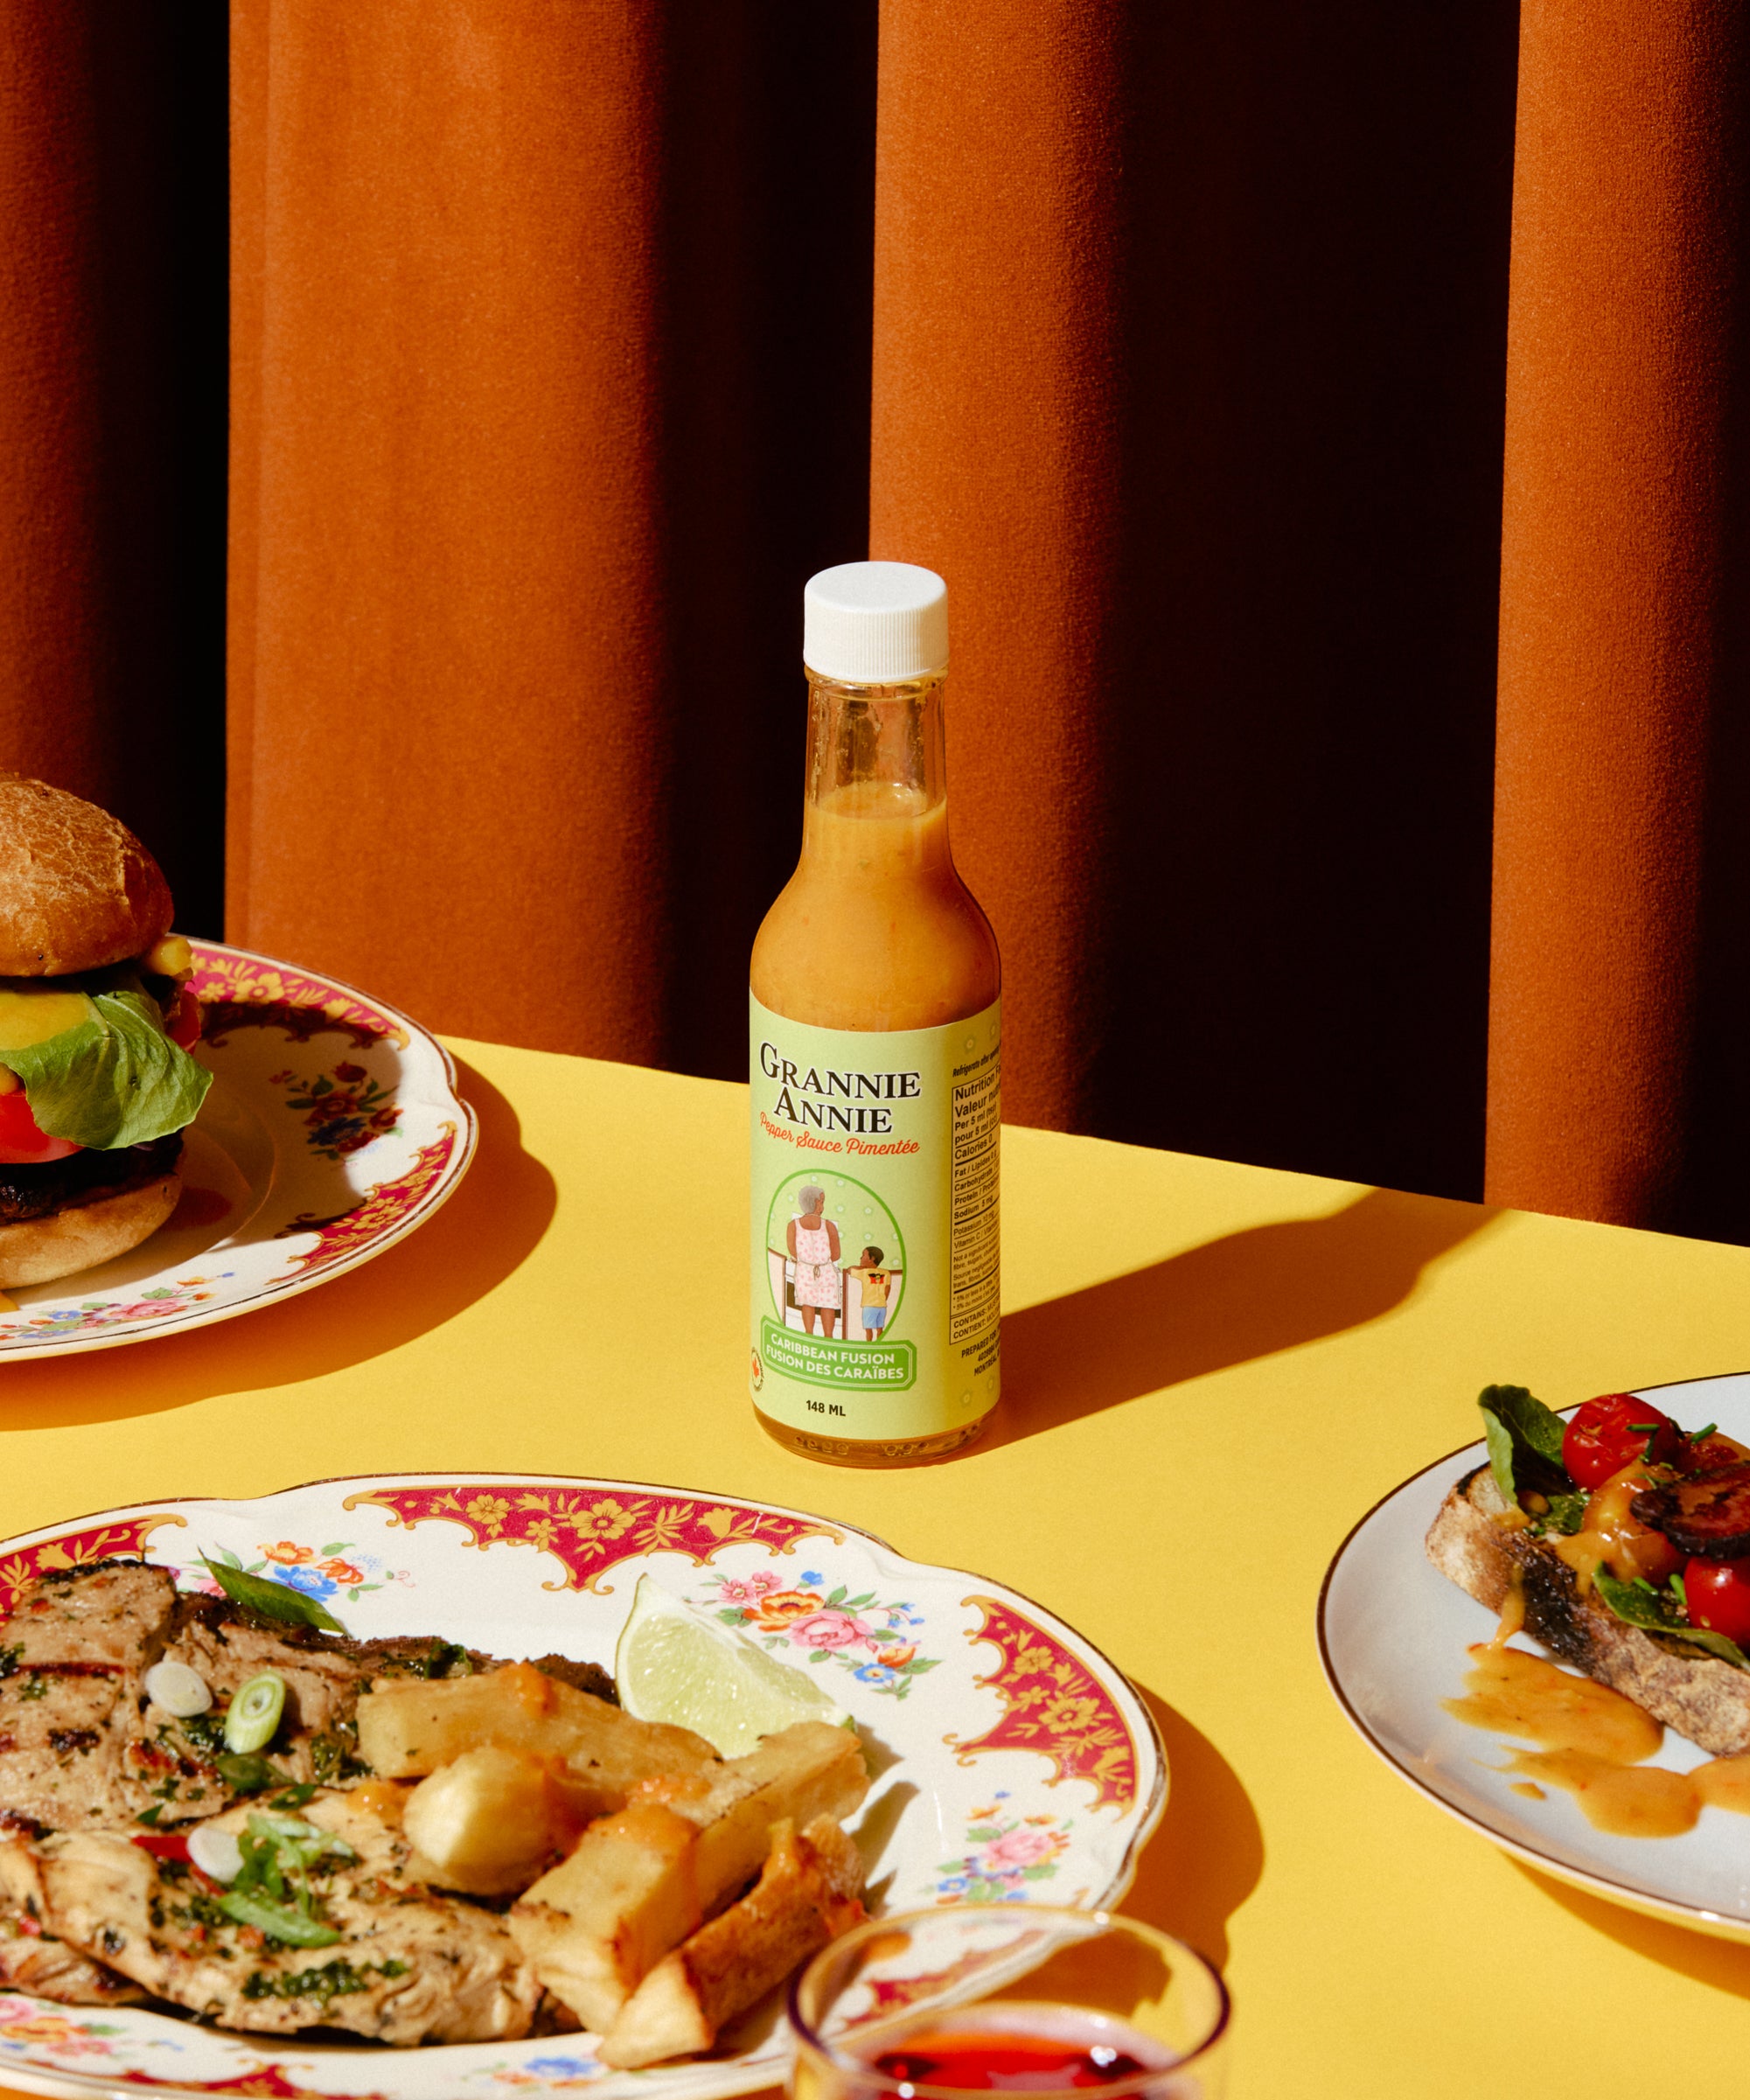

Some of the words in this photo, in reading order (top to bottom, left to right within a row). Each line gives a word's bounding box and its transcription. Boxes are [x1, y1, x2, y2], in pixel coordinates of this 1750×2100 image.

[760, 1043, 921, 1099] GRANNIE
[955, 1072, 995, 1101] Nutrition
[774, 1087, 893, 1133] ANNIE
[955, 1096, 987, 1118] Valeur
[760, 1112, 794, 1142] Pepper
[796, 1131, 843, 1153] Sauce
[846, 1138, 920, 1155] Pimentée
[955, 1120, 969, 1131] Per
[971, 1116, 975, 1125] 5
[955, 1130, 973, 1146] pour
[975, 1127, 980, 1135] 5
[955, 1139, 987, 1160] Calories
[954, 1168, 993, 1191] Carbohydrate
[955, 1169, 966, 1177] Fat
[954, 1191, 979, 1205] Protein
[954, 1204, 980, 1219] Sodium
[953, 1308, 987, 1328] CONTAINS:
[771, 1333, 837, 1362] CARIBBEAN
[840, 1353, 895, 1364] FUSION
[766, 1344, 804, 1370] FUSION
[806, 1362, 831, 1376] DES
[833, 1363, 904, 1379] CARAÏBES
[805, 1400, 826, 1413] 148
[828, 1404, 847, 1417] ML
